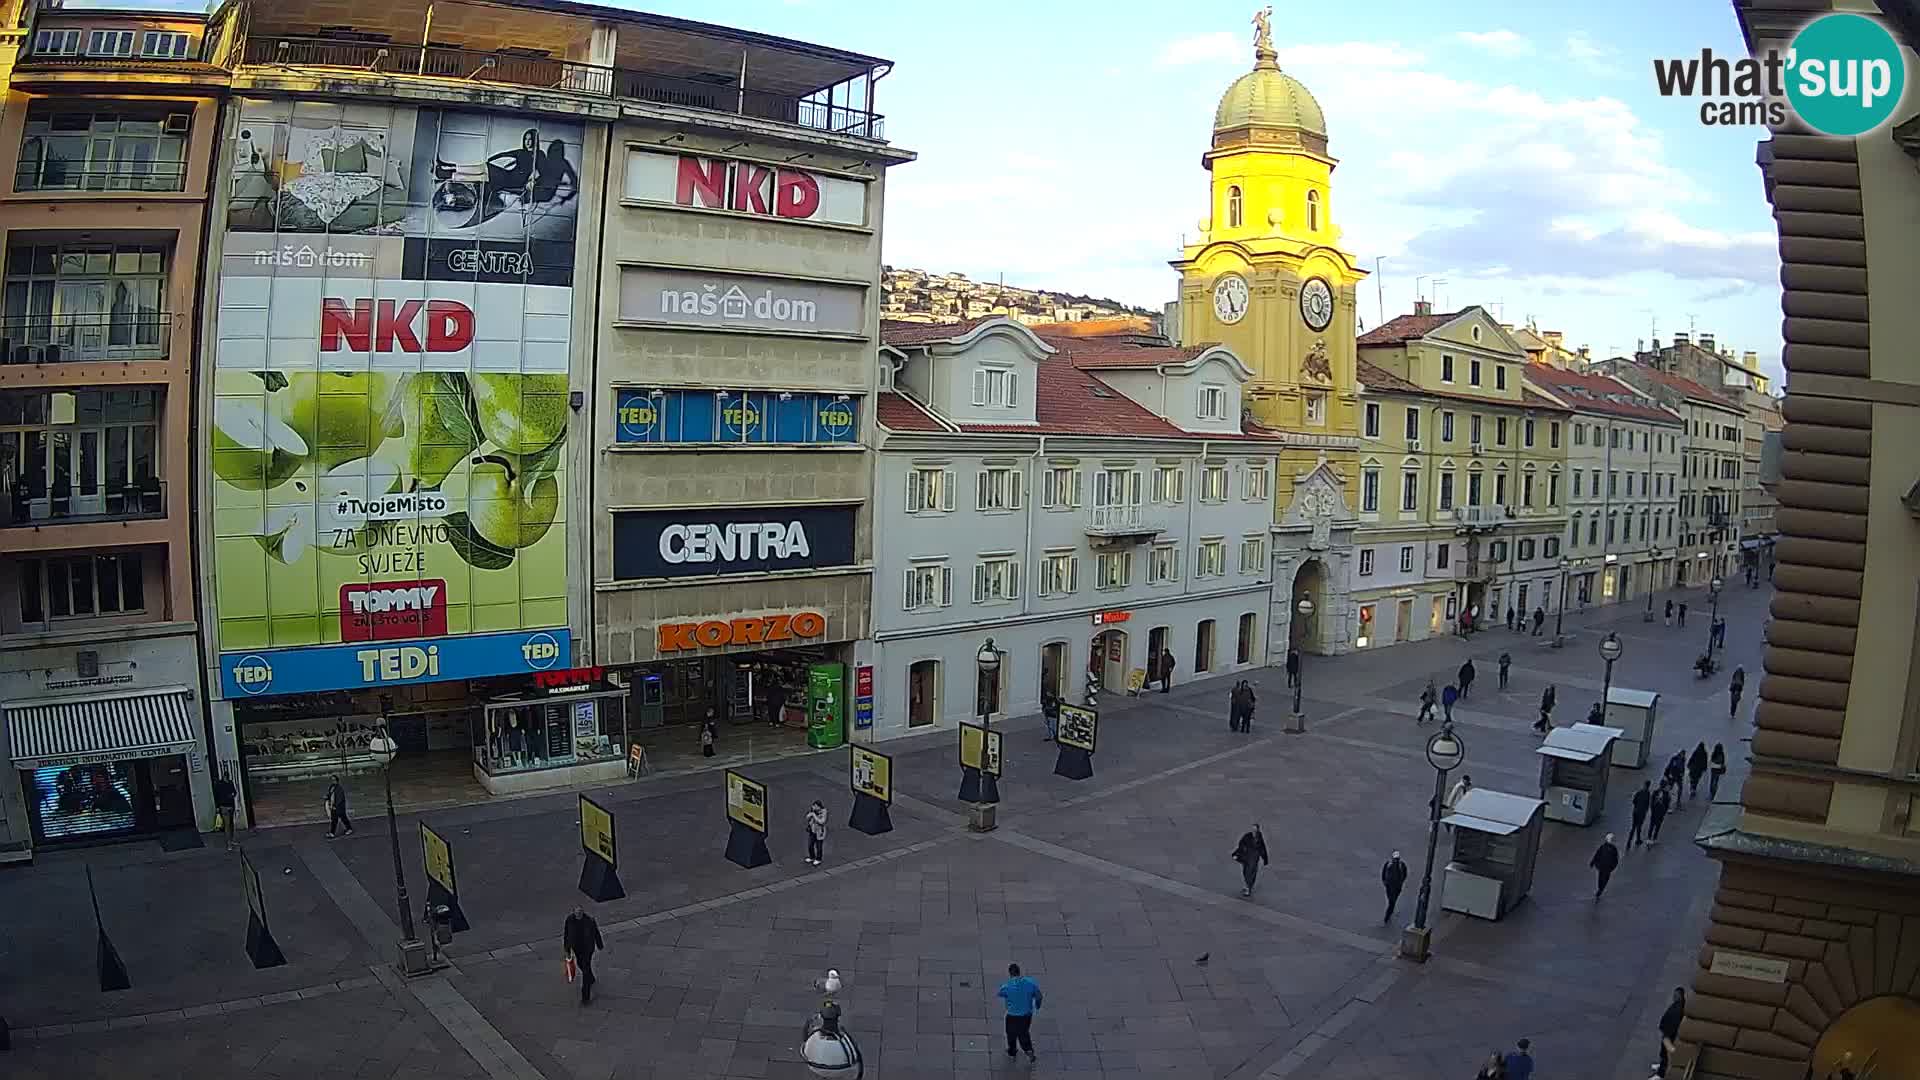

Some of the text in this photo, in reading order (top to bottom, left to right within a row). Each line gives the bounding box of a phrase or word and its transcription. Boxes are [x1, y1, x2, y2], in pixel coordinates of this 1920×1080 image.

[676, 157, 820, 219] NKD
[254, 244, 366, 268] naš dom
[447, 249, 535, 275] CENTRA
[661, 284, 816, 323] naš dom
[320, 297, 476, 353] NKD
[337, 495, 446, 517] #TvojeMisto
[333, 523, 450, 549] ZA DNEVNO
[658, 520, 810, 564] CENTRA
[359, 547, 426, 575] SVJEŽE
[347, 586, 438, 614] TOMMY
[658, 612, 826, 652] KORZO
[357, 645, 440, 682] TEDi
[521, 642, 560, 660] TEDi
[232, 666, 272, 683] TEDi
